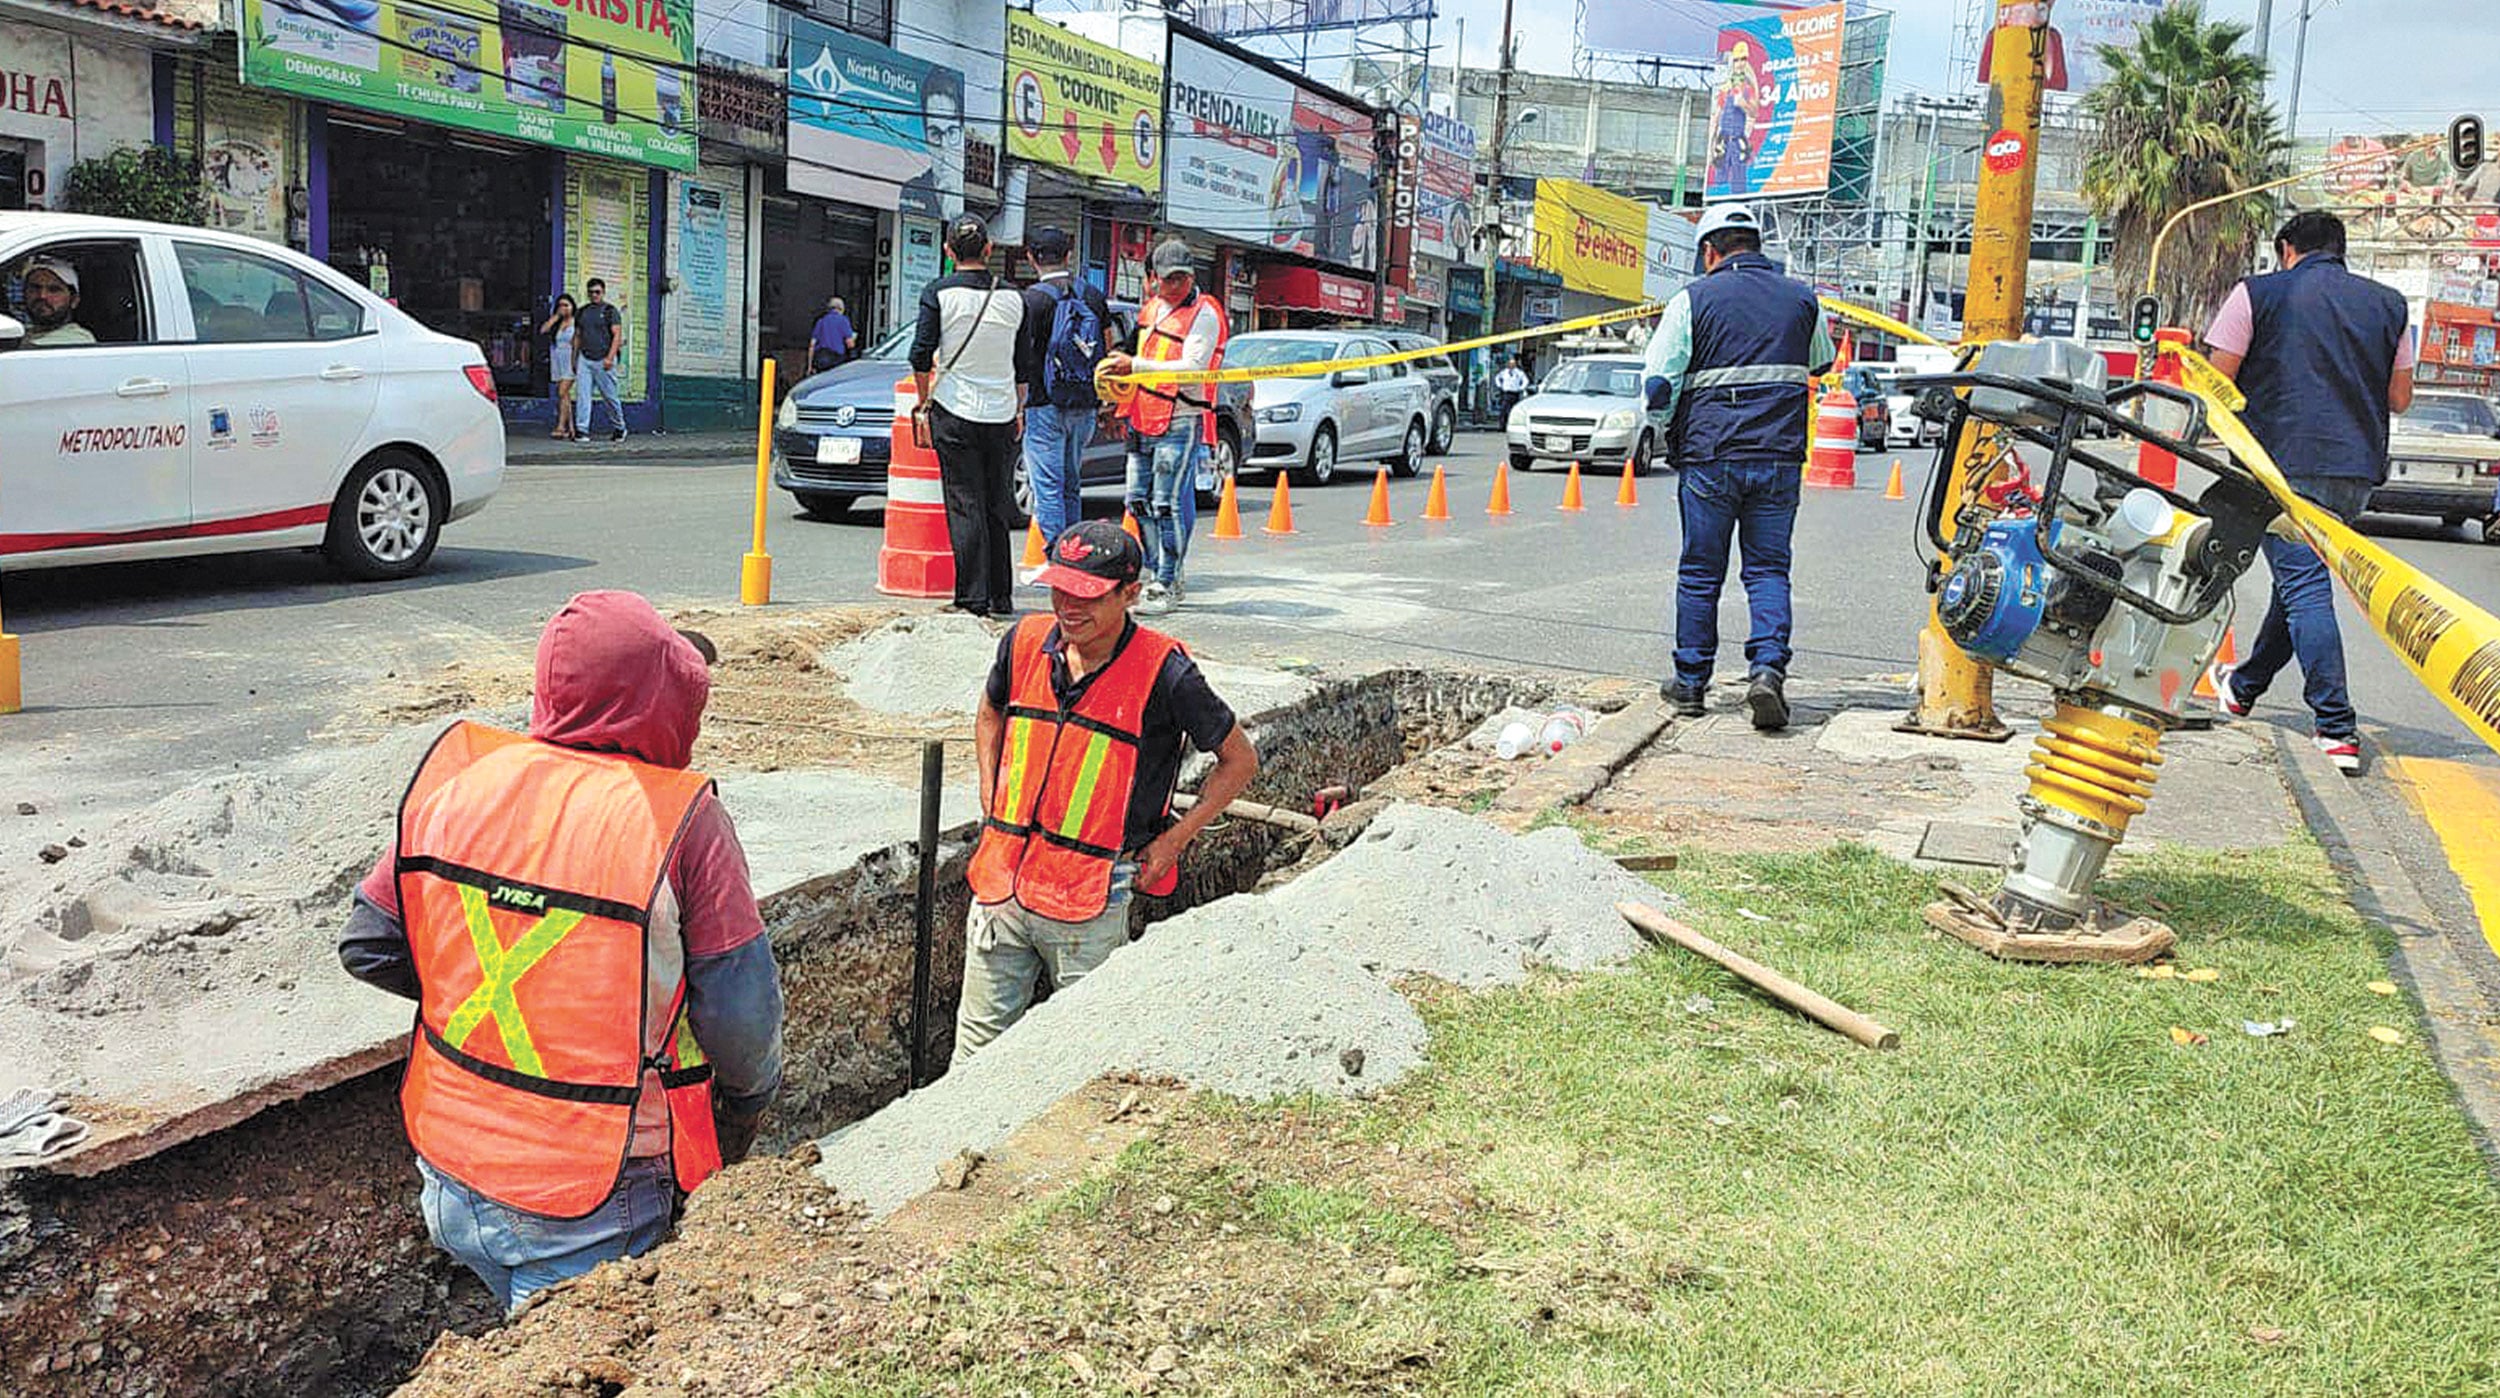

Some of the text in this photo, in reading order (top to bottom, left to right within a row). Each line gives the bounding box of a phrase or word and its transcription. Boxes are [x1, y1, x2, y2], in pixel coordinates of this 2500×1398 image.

[1781, 12, 1838, 37] ALCIONE
[1010, 24, 1113, 79] ESTACIONAMIENTO
[285, 59, 362, 88] DEMOGRASS
[847, 59, 879, 83] North
[1760, 84, 1781, 106] 34
[1175, 82, 1279, 142] PRENDAMEX
[1424, 111, 1475, 147] OPTICA
[1395, 124, 1418, 229] POLLOS
[1592, 229, 1638, 270] elektra
[59, 424, 186, 454] METROPOLITANO
